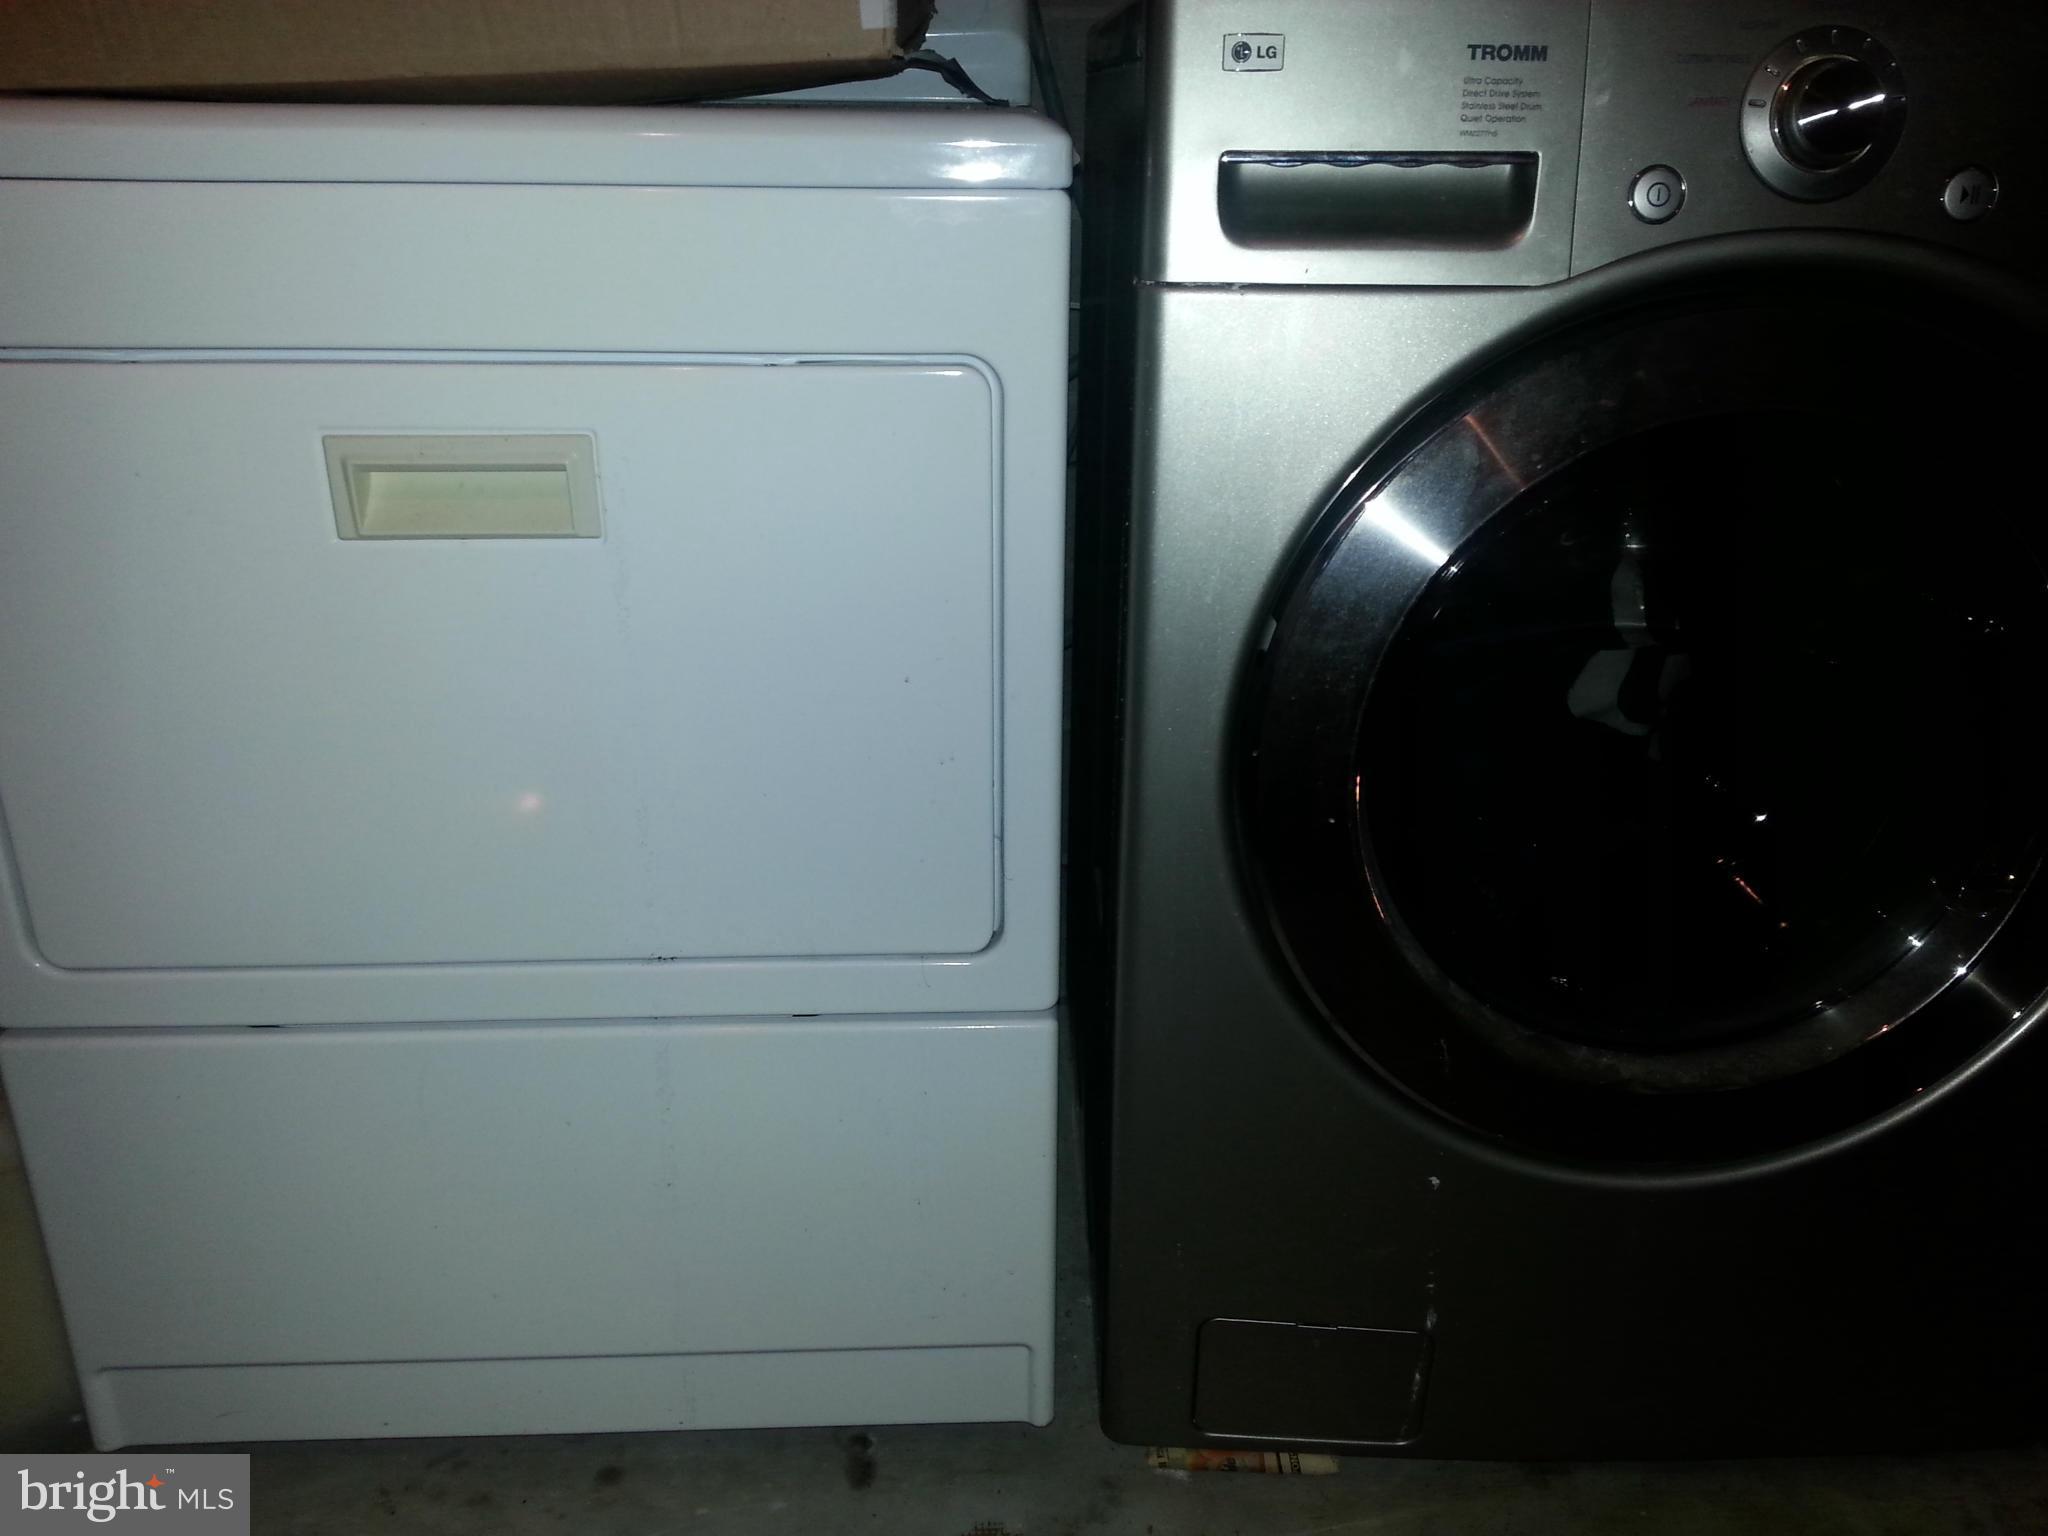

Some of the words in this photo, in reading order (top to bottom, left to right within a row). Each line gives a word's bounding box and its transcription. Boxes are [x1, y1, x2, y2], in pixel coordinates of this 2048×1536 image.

[1256, 45, 1277, 59] LG
[1467, 44, 1549, 62] TROMM
[1485, 77, 1523, 86] Capacity
[1462, 89, 1487, 97] Direct
[1512, 90, 1541, 99] System
[1461, 102, 1496, 110] Stainless
[1498, 102, 1518, 110] Steel
[1460, 114, 1483, 122] Quiet
[1485, 114, 1526, 123] Operation
